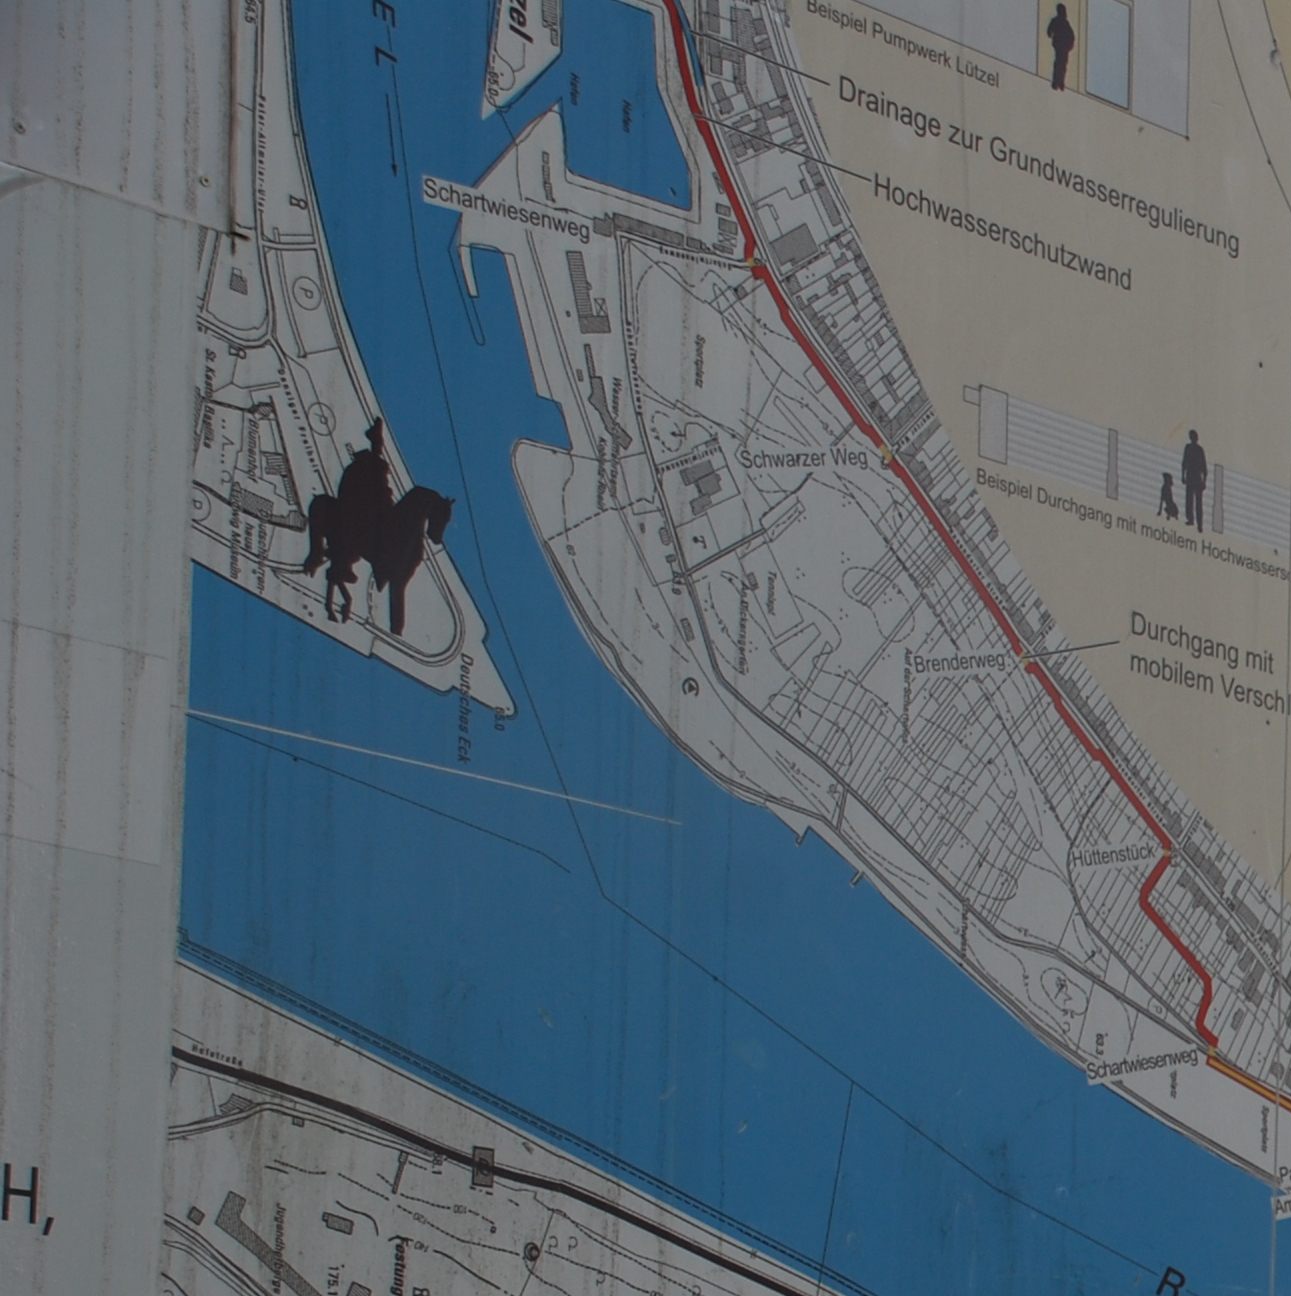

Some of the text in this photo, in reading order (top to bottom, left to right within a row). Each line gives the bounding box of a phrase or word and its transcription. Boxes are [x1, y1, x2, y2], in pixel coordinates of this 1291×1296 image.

[806, 0, 1000, 89] Beispiel Pumpwerk Lützel
[838, 74, 1241, 259] Drainage zur Grundwasserregulierung
[424, 177, 591, 244] Schartwiesenweg
[873, 172, 1133, 291] Hochwasserschutzwand
[740, 450, 827, 469] Schwarzer
[829, 448, 869, 470] Weg
[976, 467, 1034, 501] Beispiel
[1036, 487, 1113, 530] Durchgang
[1116, 516, 1138, 534] mit
[1140, 523, 1198, 553] mobilem
[913, 652, 1006, 674] Brenderweg
[1130, 611, 1275, 675] Durchgang mit
[1130, 653, 1215, 694] mobilem
[457, 736, 472, 764] Eck
[1072, 842, 1156, 868] Hüttenstück
[1086, 1048, 1199, 1081] Schartwiesenweg
